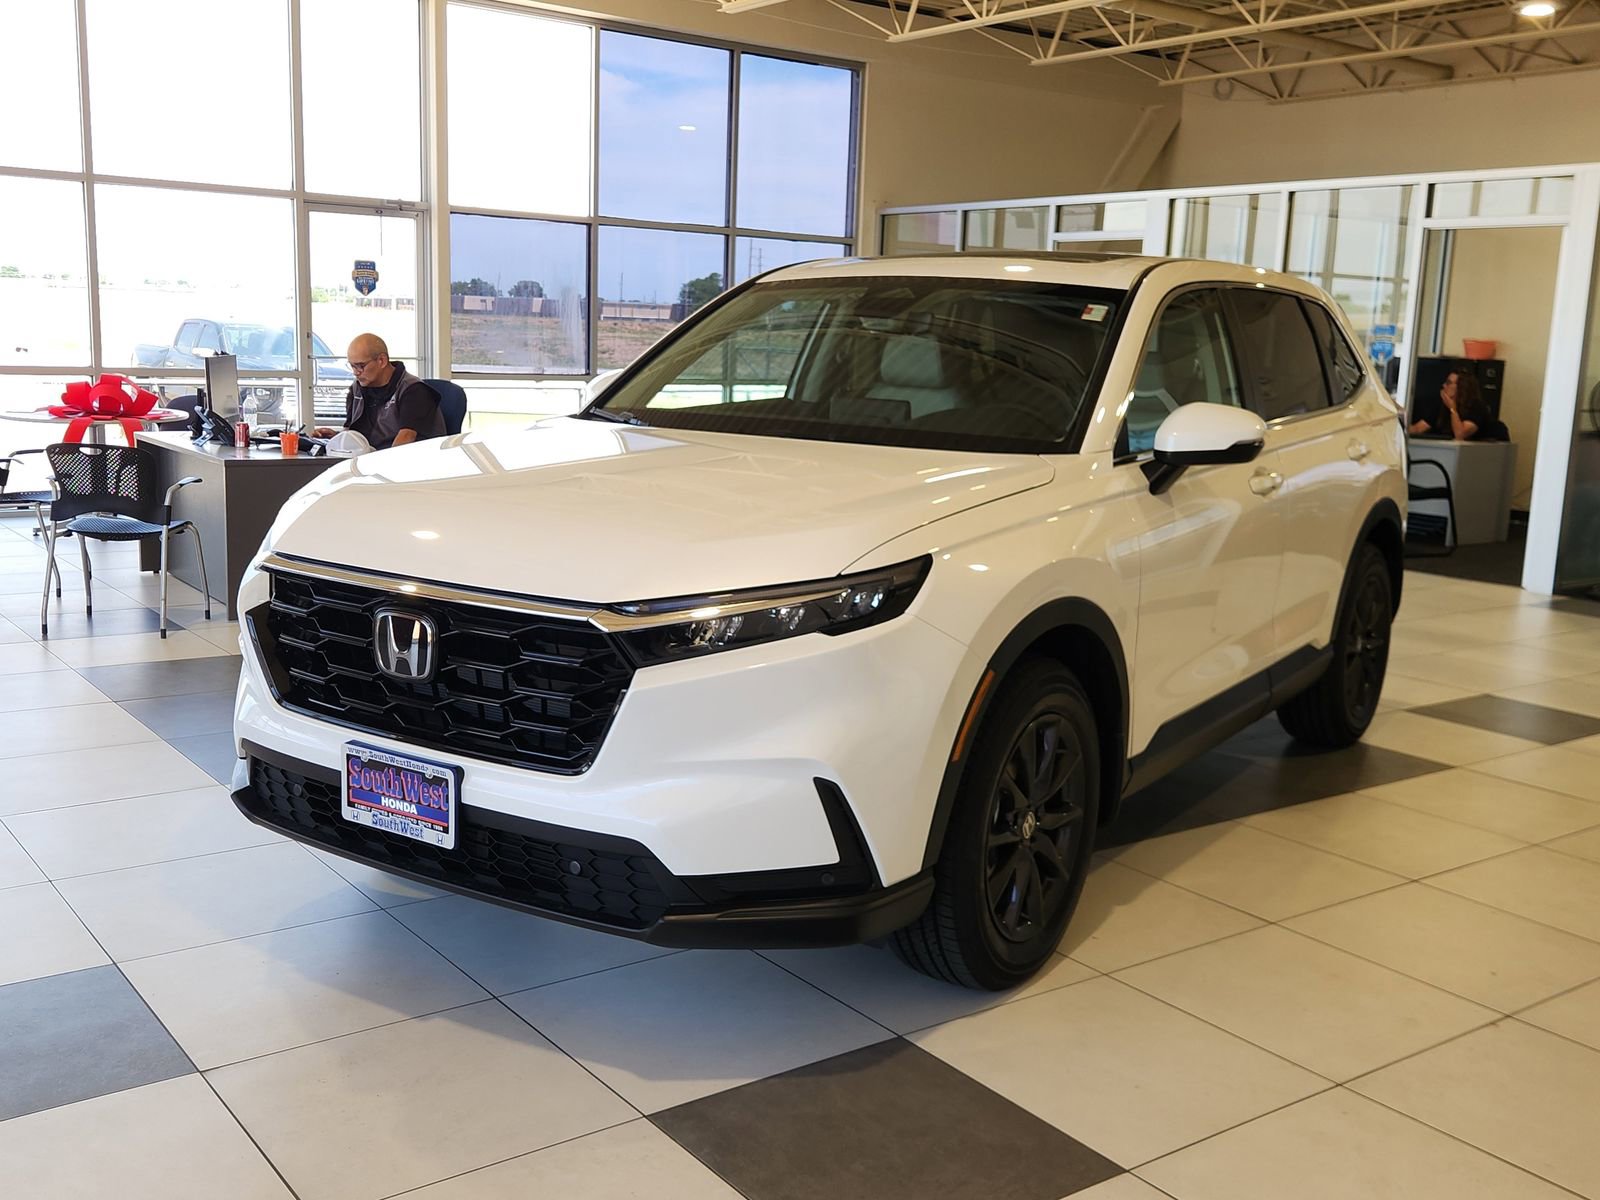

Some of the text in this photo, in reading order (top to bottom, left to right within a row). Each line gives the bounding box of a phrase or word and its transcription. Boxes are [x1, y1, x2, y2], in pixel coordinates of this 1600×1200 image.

[348, 746, 447, 777] wwwSouthWestHondacom
[349, 757, 449, 811] SouthWest
[381, 796, 418, 815] HONDA
[371, 812, 424, 838] SouthWest
